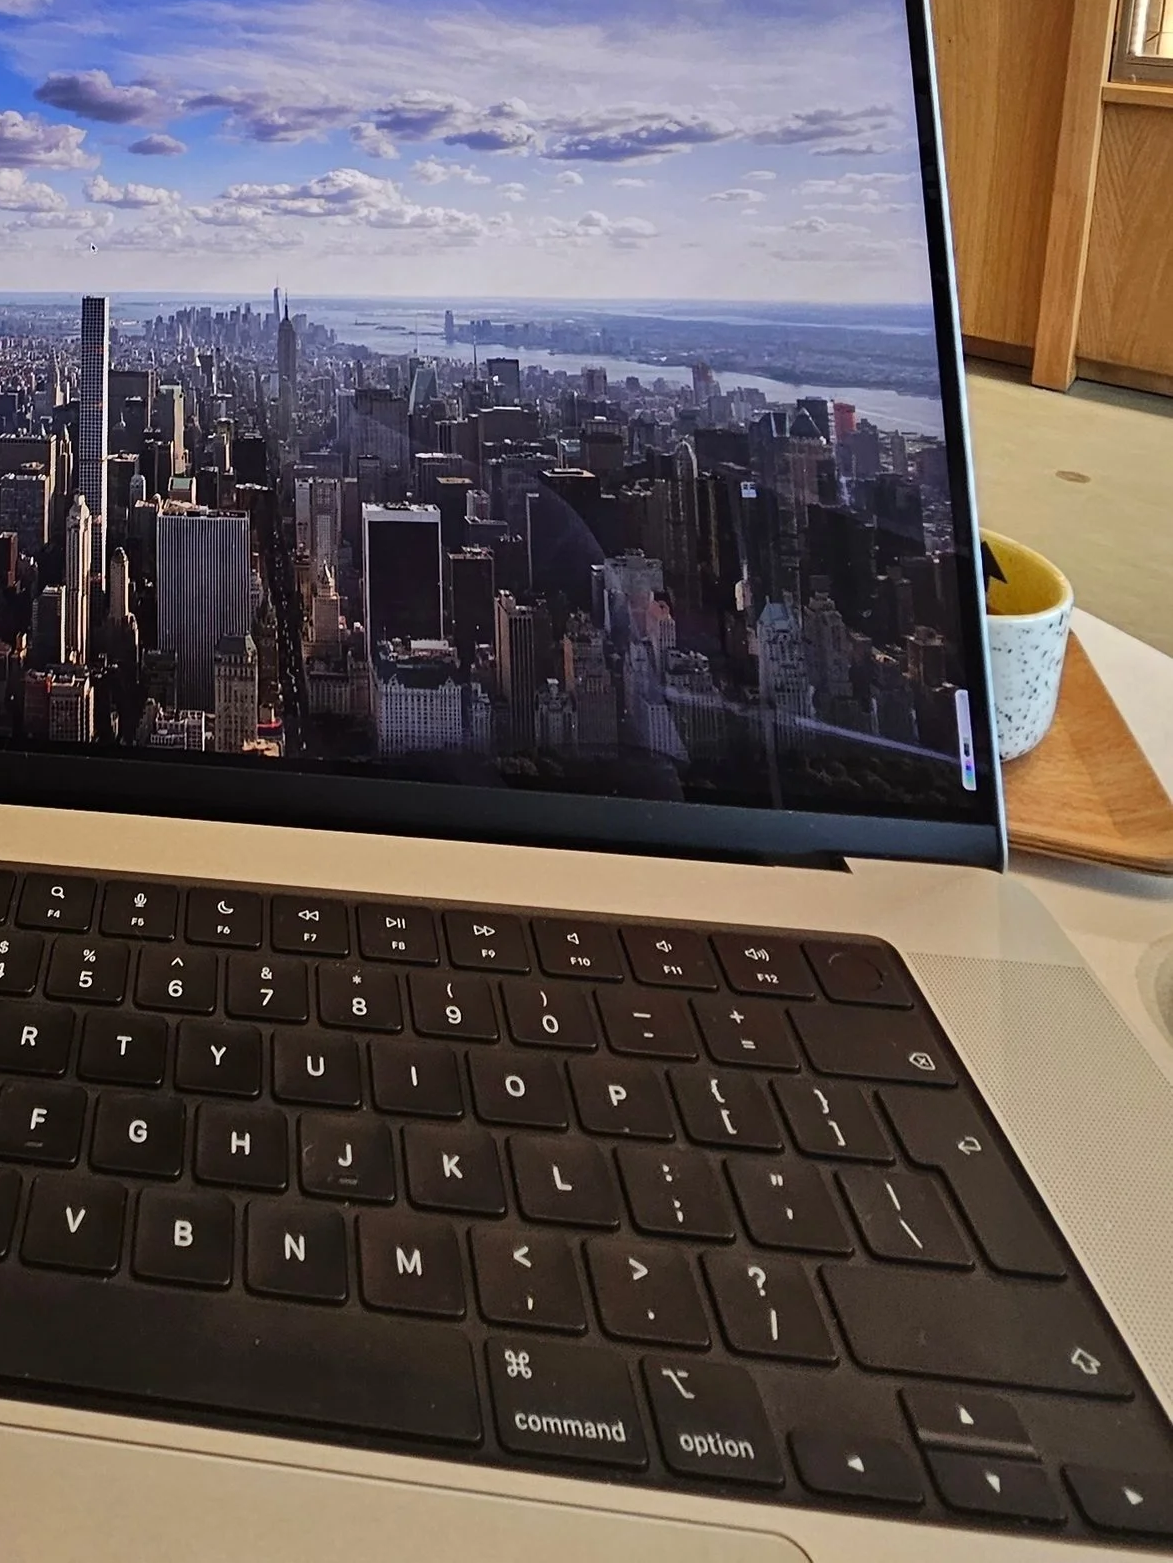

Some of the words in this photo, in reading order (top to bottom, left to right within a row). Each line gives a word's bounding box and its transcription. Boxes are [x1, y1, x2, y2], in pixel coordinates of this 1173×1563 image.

[47, 909, 61, 918] F4
[131, 917, 145, 927] F5
[217, 925, 231, 935] F6
[303, 932, 317, 942] F7
[391, 940, 406, 950] F8
[481, 949, 496, 958] F9
[570, 956, 591, 967] F10
[663, 965, 683, 975] F11
[78, 970, 93, 988] 5
[168, 979, 183, 998] 6
[756, 973, 779, 984] F12
[260, 988, 274, 1006] 7
[352, 997, 368, 1016] 8
[445, 1005, 462, 1024] 9
[542, 1014, 559, 1034] 0
[20, 1025, 38, 1047] R
[116, 1035, 133, 1056] T
[210, 1044, 227, 1066] Y
[306, 1055, 325, 1077] U
[505, 1075, 526, 1097] O
[608, 1084, 627, 1107] P
[30, 1107, 48, 1130] F
[128, 1119, 148, 1143] G
[230, 1131, 251, 1156] H
[337, 1143, 353, 1167] J
[442, 1153, 463, 1179] K
[552, 1165, 573, 1191] L
[65, 1206, 86, 1233] V
[173, 1219, 194, 1247] B
[284, 1232, 305, 1262] N
[396, 1247, 423, 1276] M
[514, 1412, 626, 1442] command
[679, 1432, 755, 1460] option
